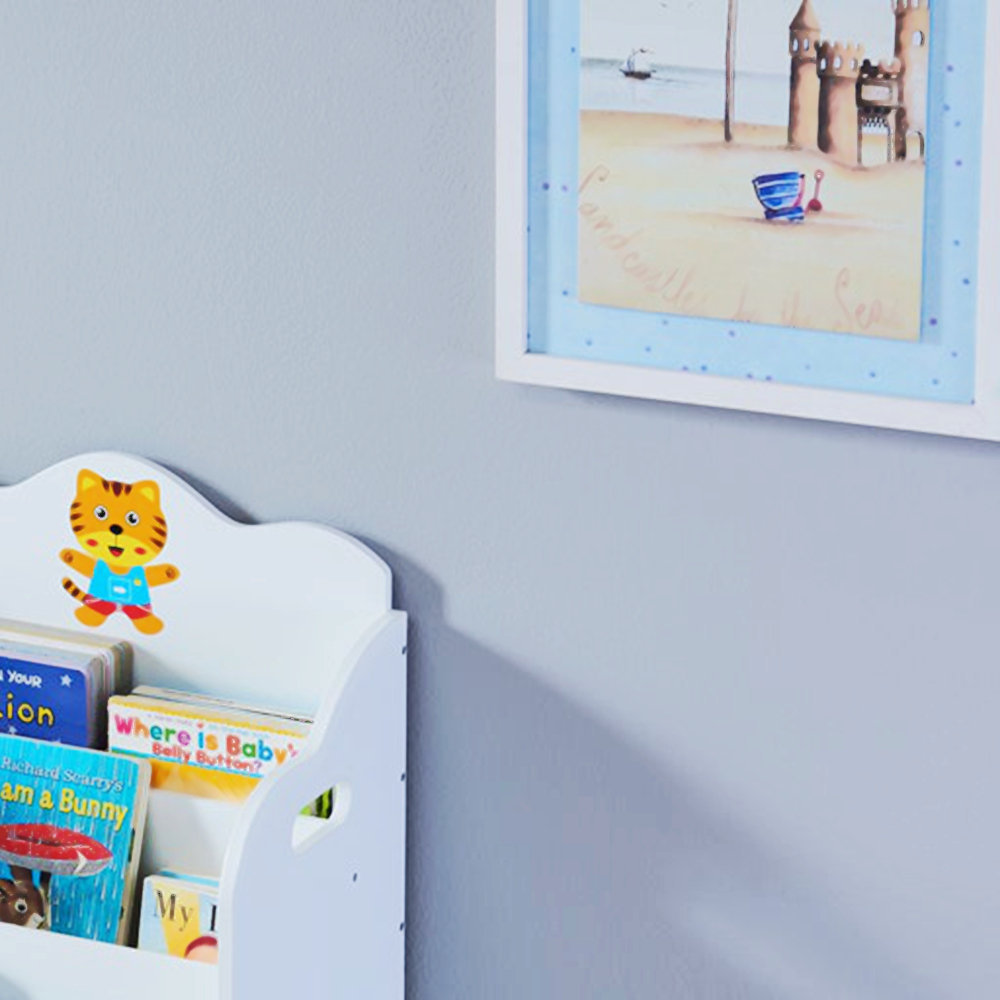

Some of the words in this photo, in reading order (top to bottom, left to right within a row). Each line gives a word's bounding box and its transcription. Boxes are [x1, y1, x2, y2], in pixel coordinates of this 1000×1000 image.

[7, 670, 43, 688] YOUR
[114, 713, 192, 747] Where
[197, 722, 219, 751] is
[0, 756, 59, 781] Richard
[63, 770, 124, 794] Scarry's
[152, 742, 190, 764] Belly
[196, 750, 262, 772] Button?
[0, 781, 35, 806] am
[39, 789, 54, 809] a
[59, 787, 128, 831] Bunny
[154, 889, 193, 931] My
